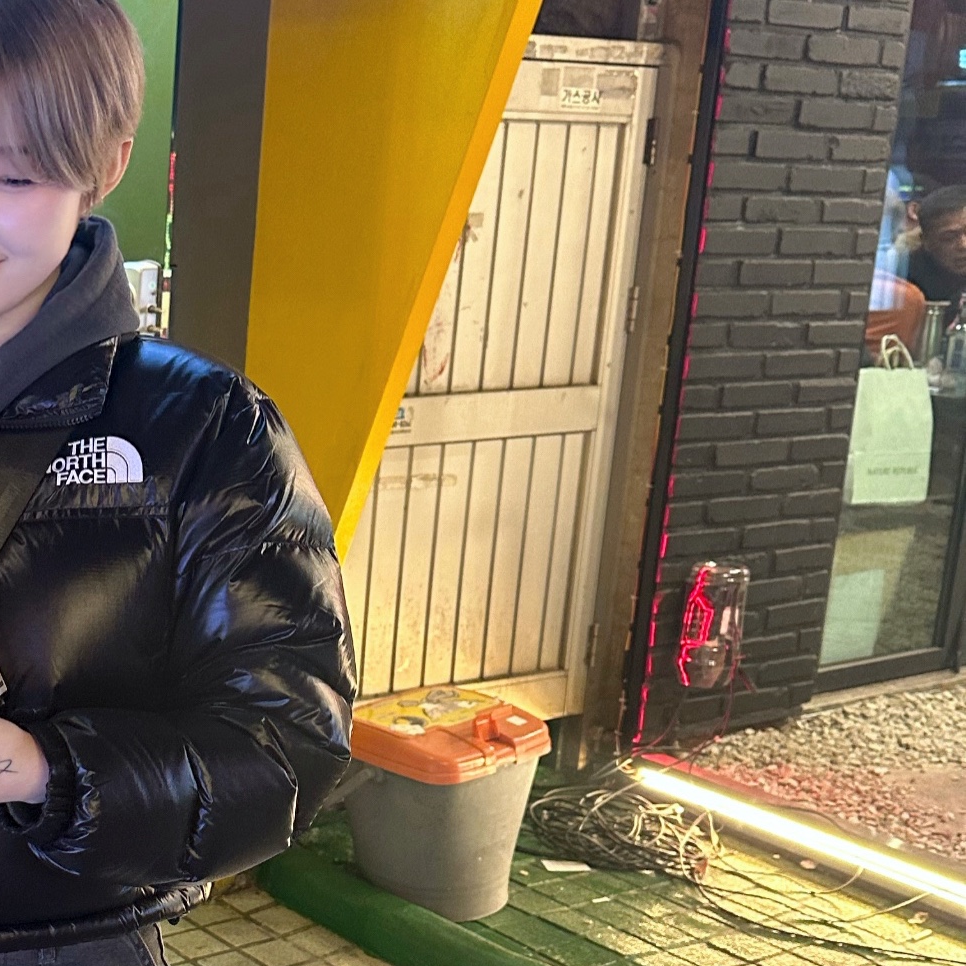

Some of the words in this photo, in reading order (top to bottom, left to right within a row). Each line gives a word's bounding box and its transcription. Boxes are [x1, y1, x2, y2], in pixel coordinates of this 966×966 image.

[68, 437, 106, 456] THE
[47, 452, 105, 474] ORTH
[56, 469, 106, 486] FACE
